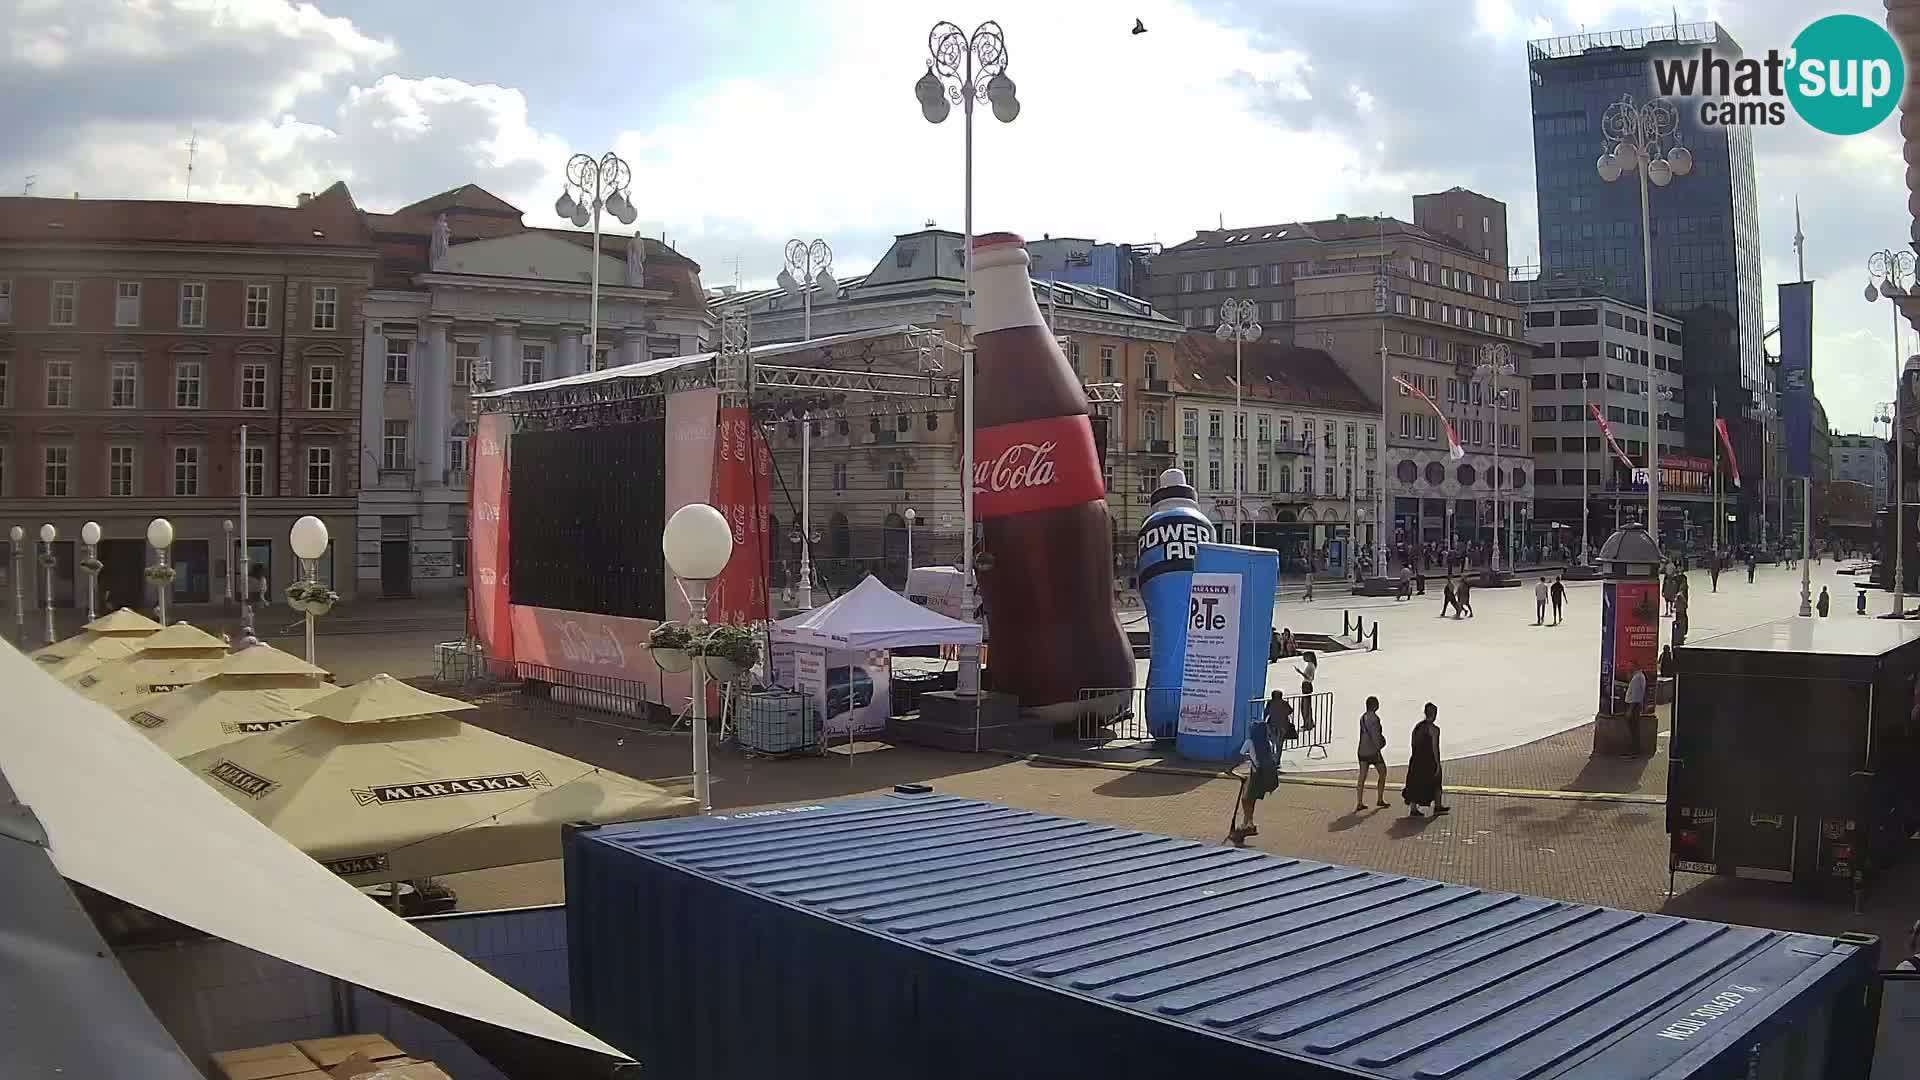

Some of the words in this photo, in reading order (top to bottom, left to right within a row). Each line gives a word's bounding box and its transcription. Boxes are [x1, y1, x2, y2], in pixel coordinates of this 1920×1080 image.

[1138, 523, 1210, 557] POWER
[1166, 541, 1198, 560] AD
[384, 776, 524, 801] MARASKA
